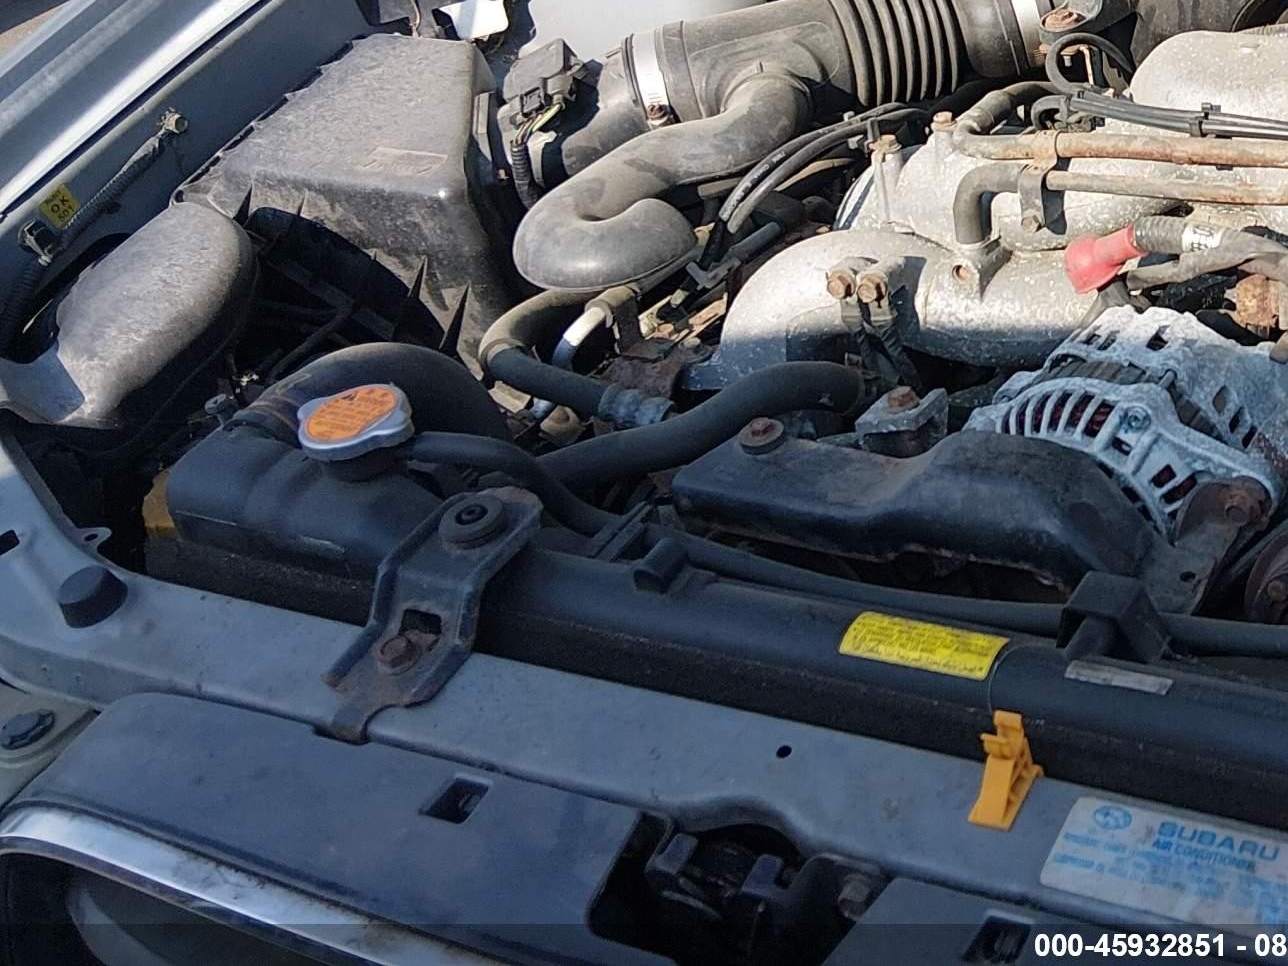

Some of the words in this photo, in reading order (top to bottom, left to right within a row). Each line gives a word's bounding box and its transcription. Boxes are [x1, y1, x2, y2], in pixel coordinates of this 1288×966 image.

[1152, 839, 1174, 852] AIR
[1174, 841, 1256, 872] CONDITIONER
[1157, 820, 1280, 862] SUBARU
